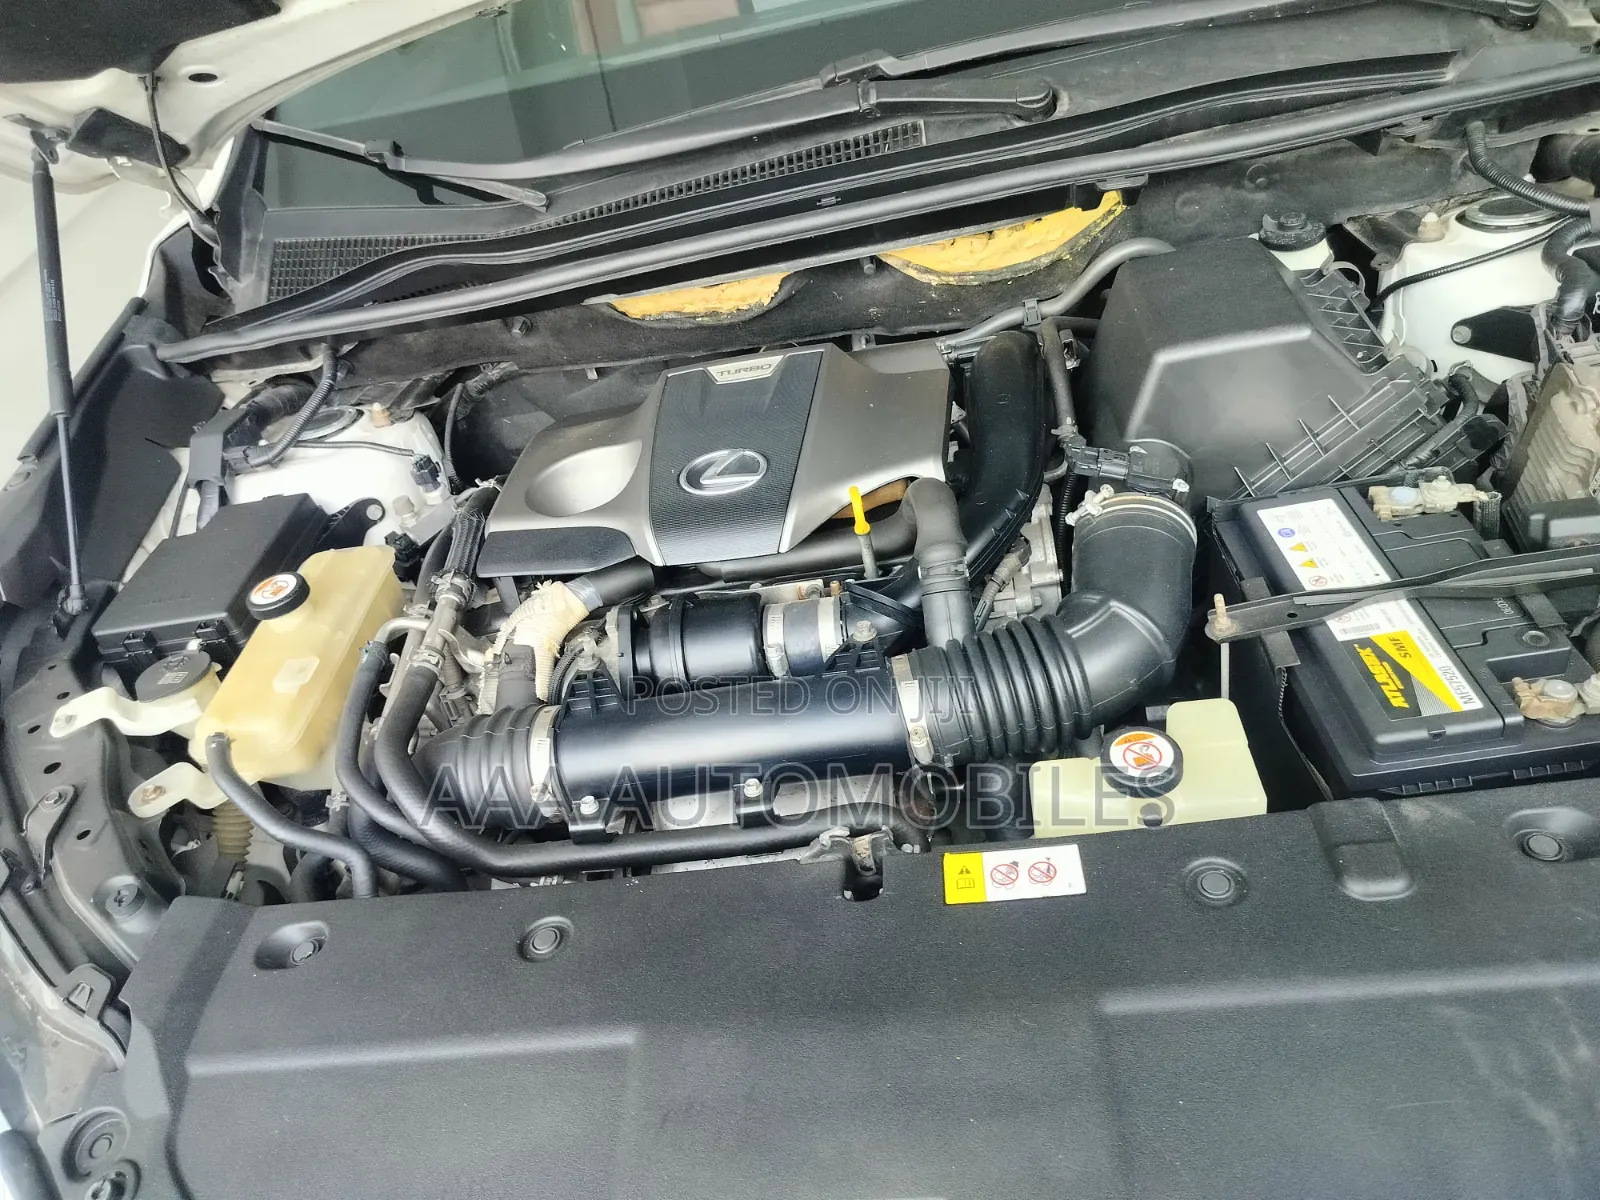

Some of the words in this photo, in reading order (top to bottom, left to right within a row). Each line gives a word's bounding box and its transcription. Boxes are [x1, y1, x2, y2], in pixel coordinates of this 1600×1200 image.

[716, 363, 772, 377] TURBO
[1387, 636, 1412, 659] SMF
[1356, 645, 1410, 709] ATLASBX
[1439, 665, 1476, 705] MF57520
